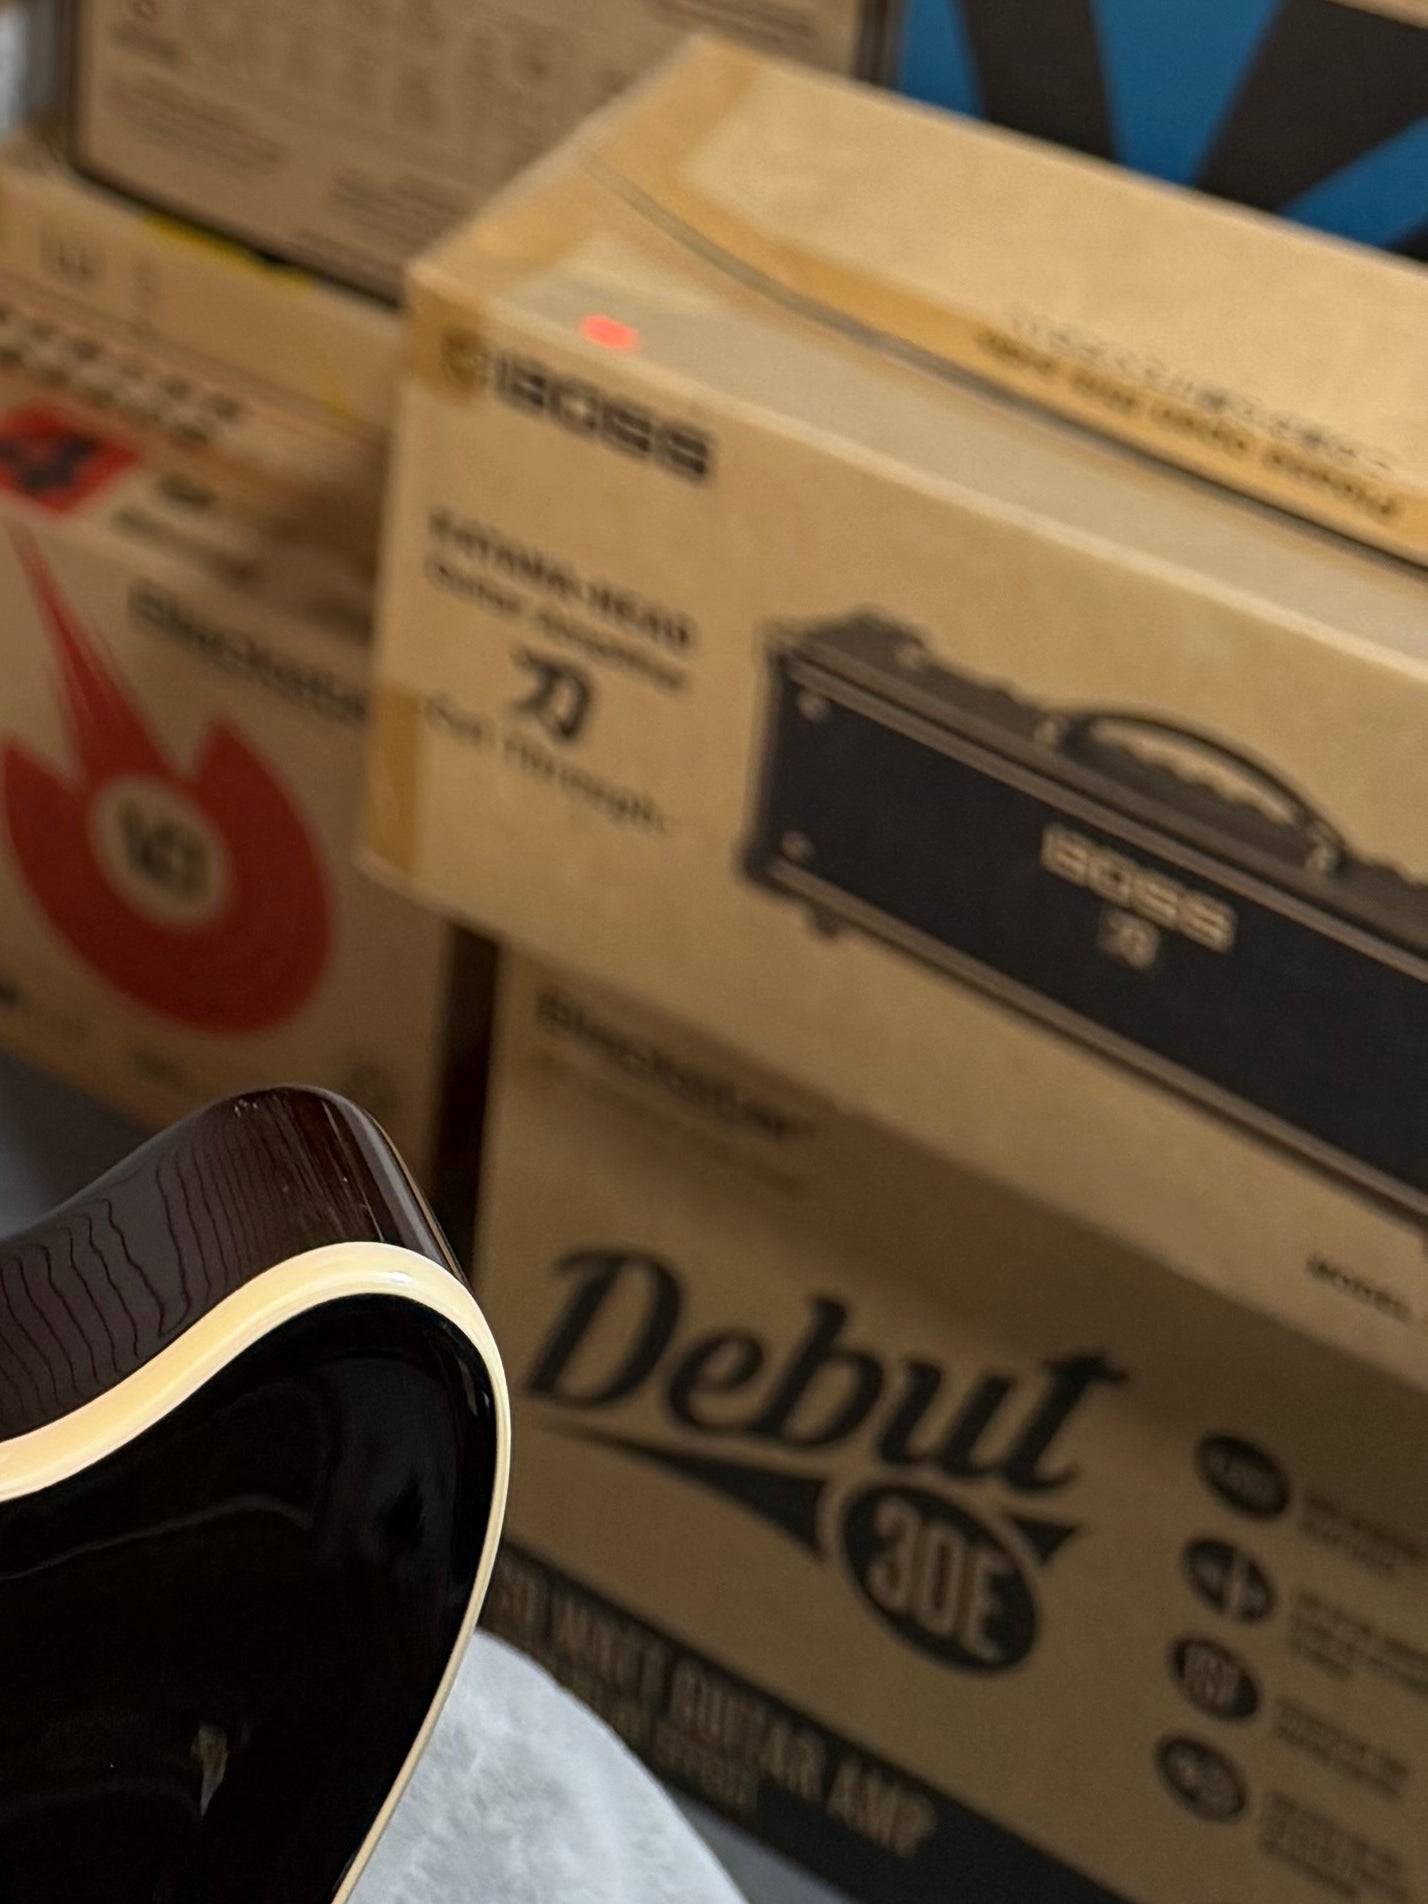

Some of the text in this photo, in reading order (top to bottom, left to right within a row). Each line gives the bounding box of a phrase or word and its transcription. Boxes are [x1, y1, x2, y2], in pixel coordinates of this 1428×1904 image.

[494, 352, 716, 486] BOSS
[1040, 821, 1238, 956] BOSS
[524, 1246, 1132, 1494] Debut
[869, 1495, 1018, 1666] 30E
